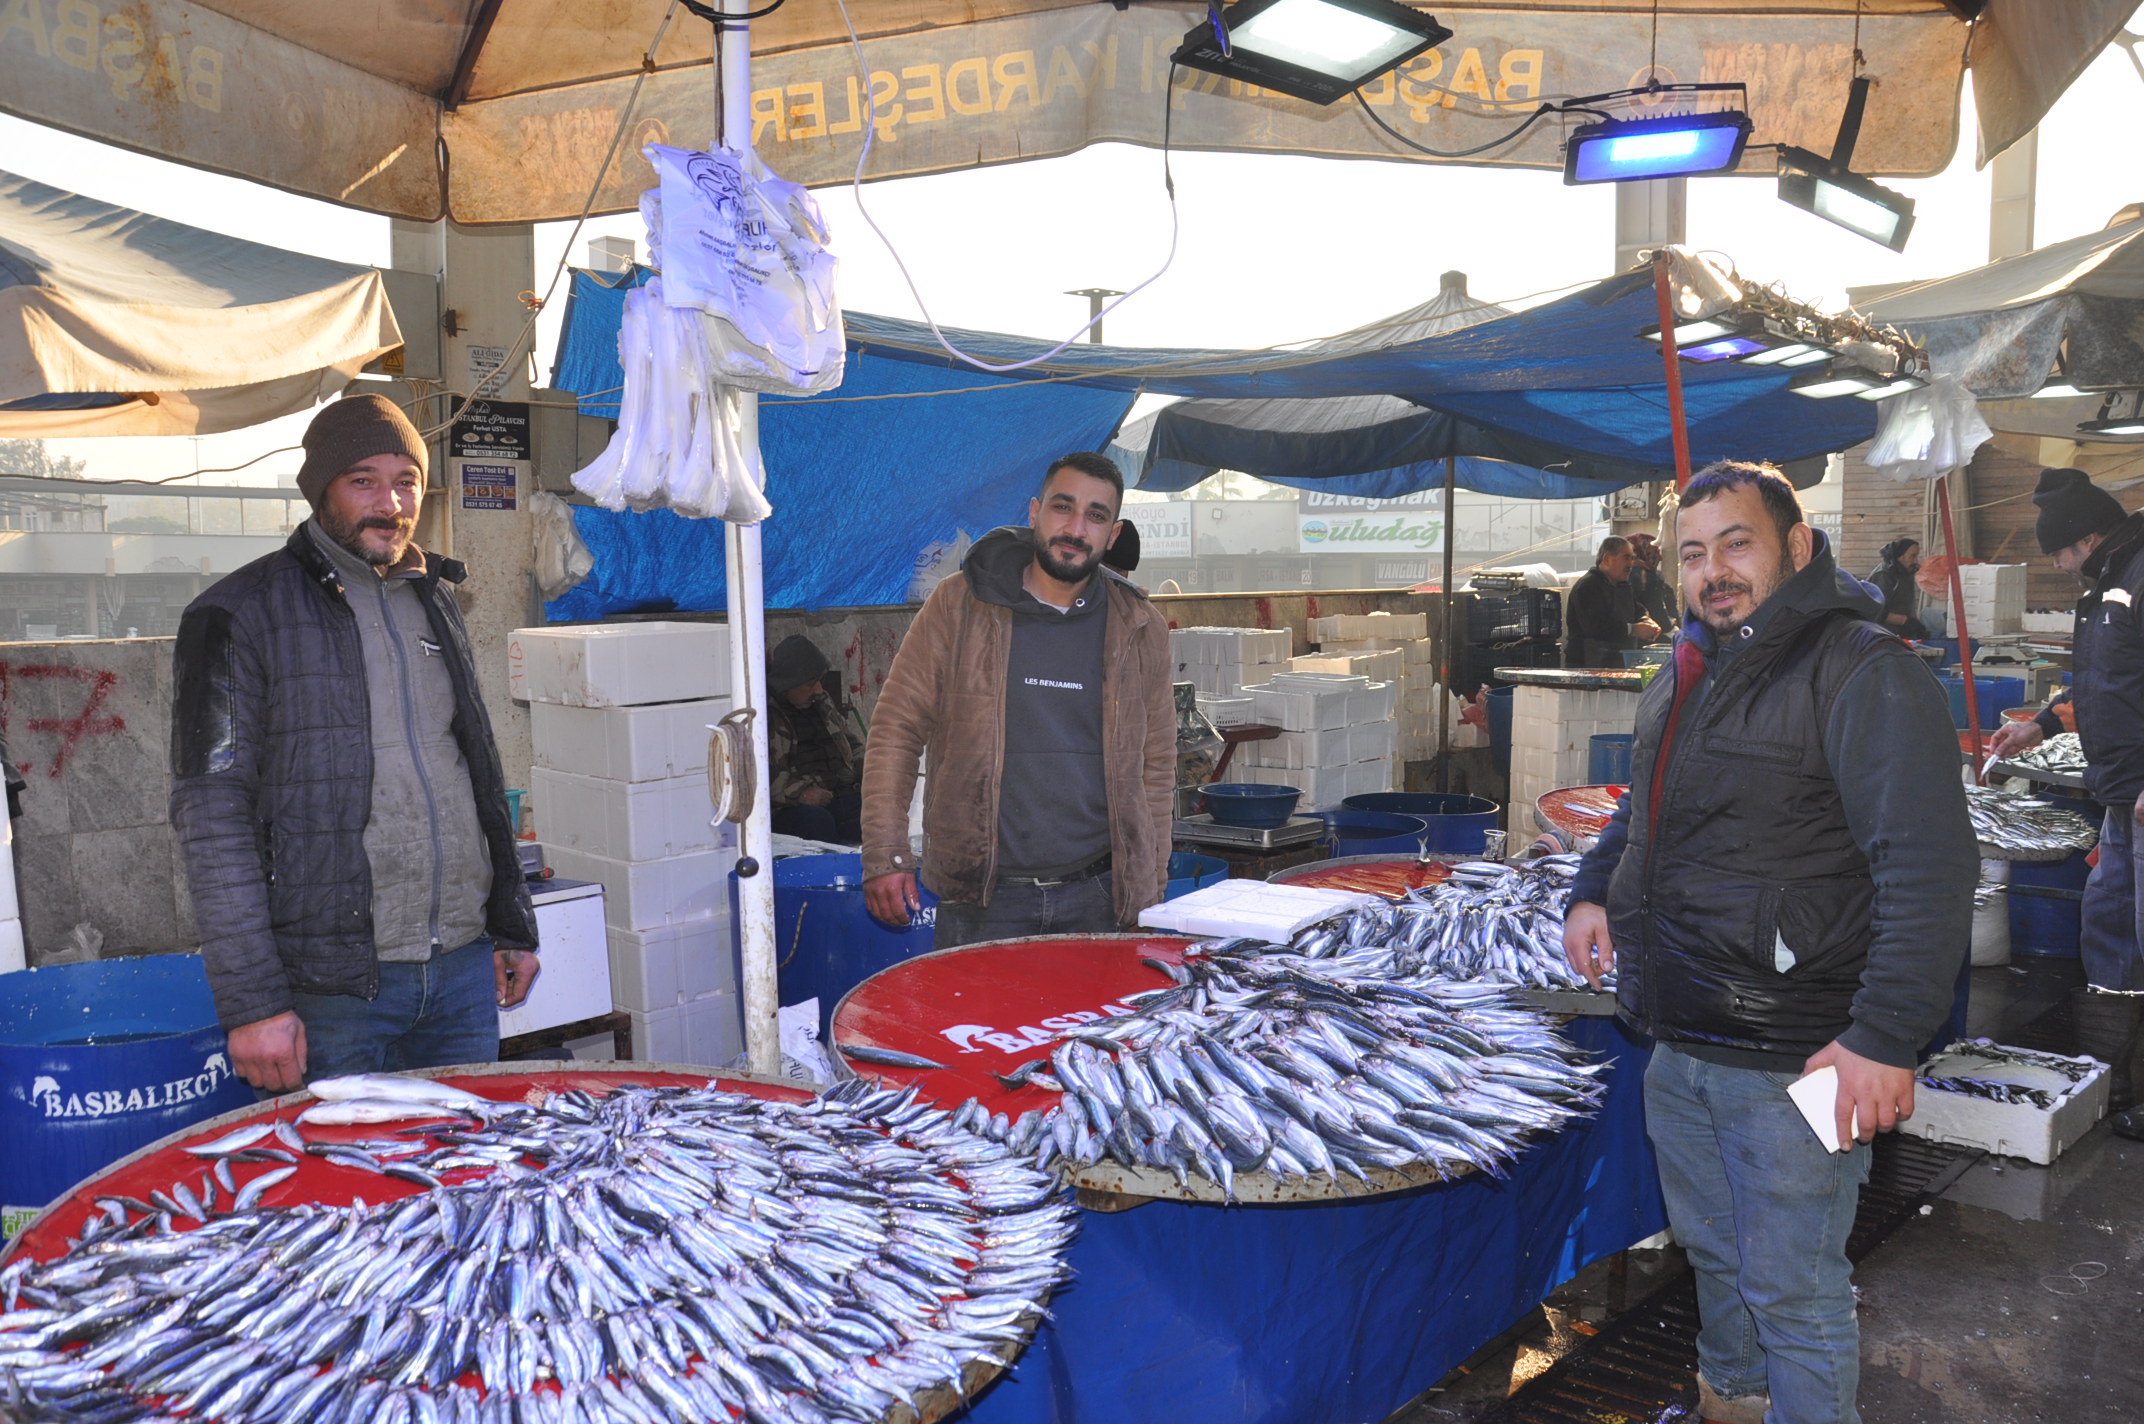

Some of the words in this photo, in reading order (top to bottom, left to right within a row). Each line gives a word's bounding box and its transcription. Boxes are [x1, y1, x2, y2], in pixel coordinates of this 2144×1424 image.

[454, 412, 487, 423] STANBUL
[1328, 517, 1445, 549] uludağ
[1025, 677, 1038, 686] LES
[1039, 679, 1083, 690] BENJAMINS
